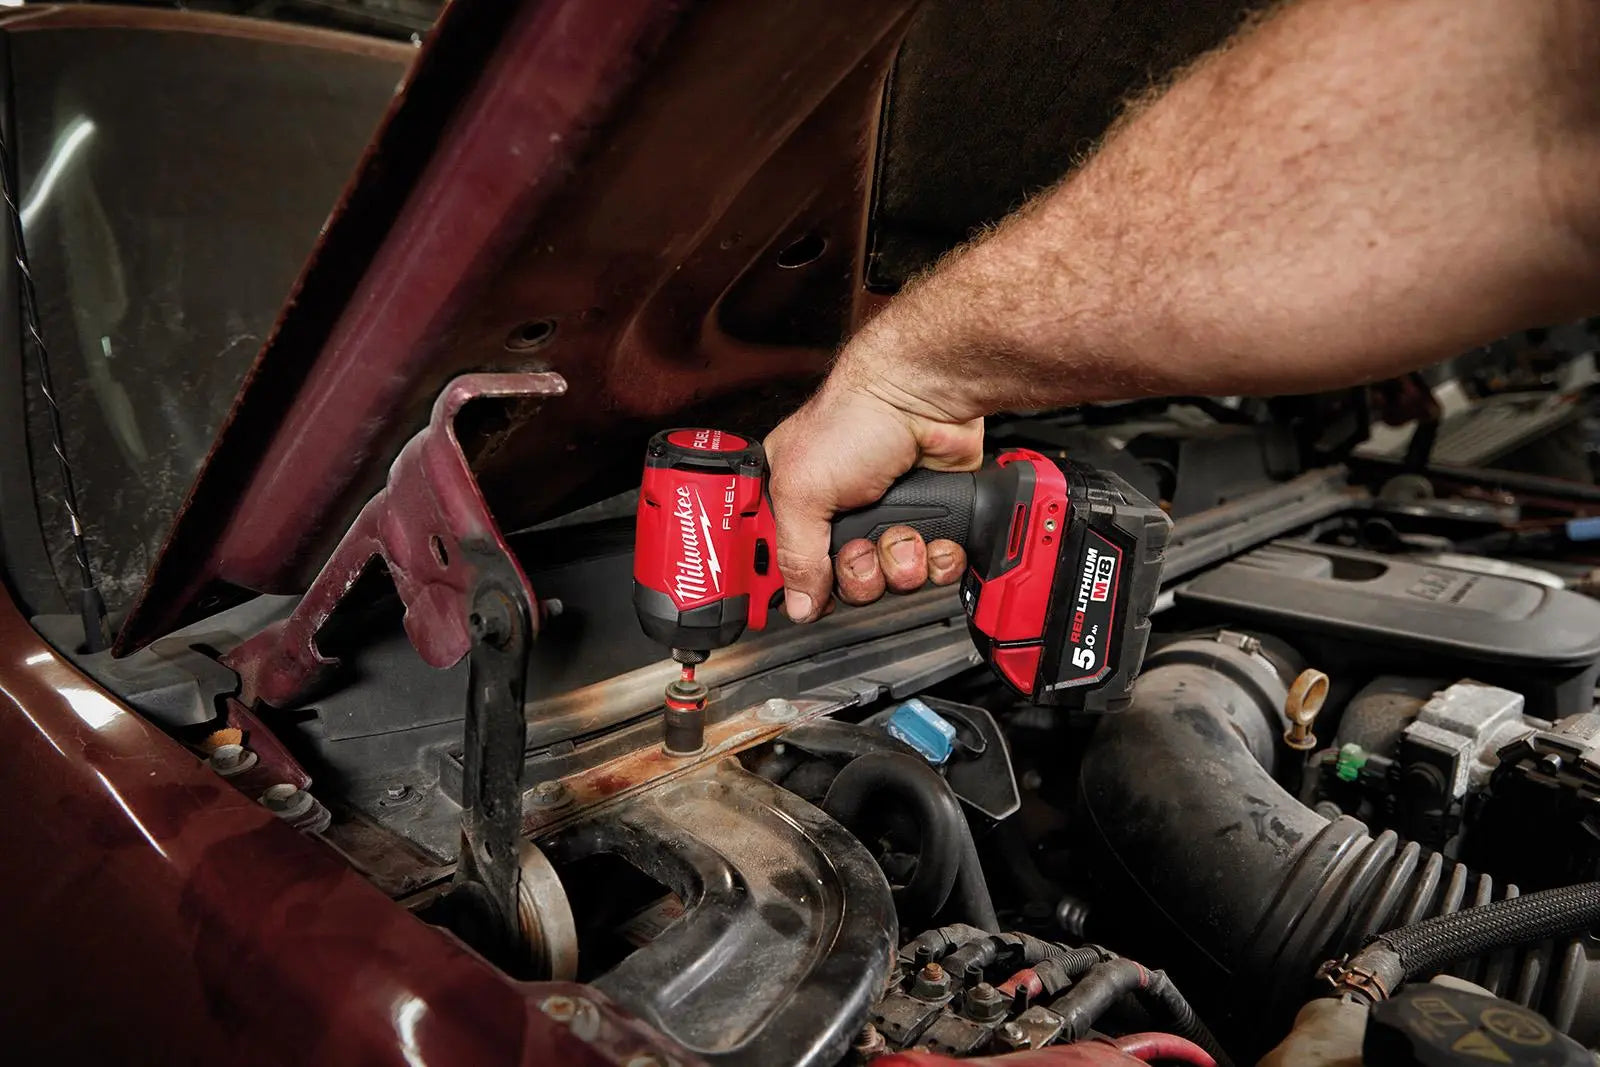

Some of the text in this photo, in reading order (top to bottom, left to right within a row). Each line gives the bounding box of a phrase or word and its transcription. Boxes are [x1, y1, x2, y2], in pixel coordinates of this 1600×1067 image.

[693, 429, 710, 449] FUEL
[722, 477, 736, 530] FUEL
[674, 485, 708, 603] Milwaukee
[1070, 547, 1099, 644] REDLITHIUM
[1092, 558, 1113, 600] M18
